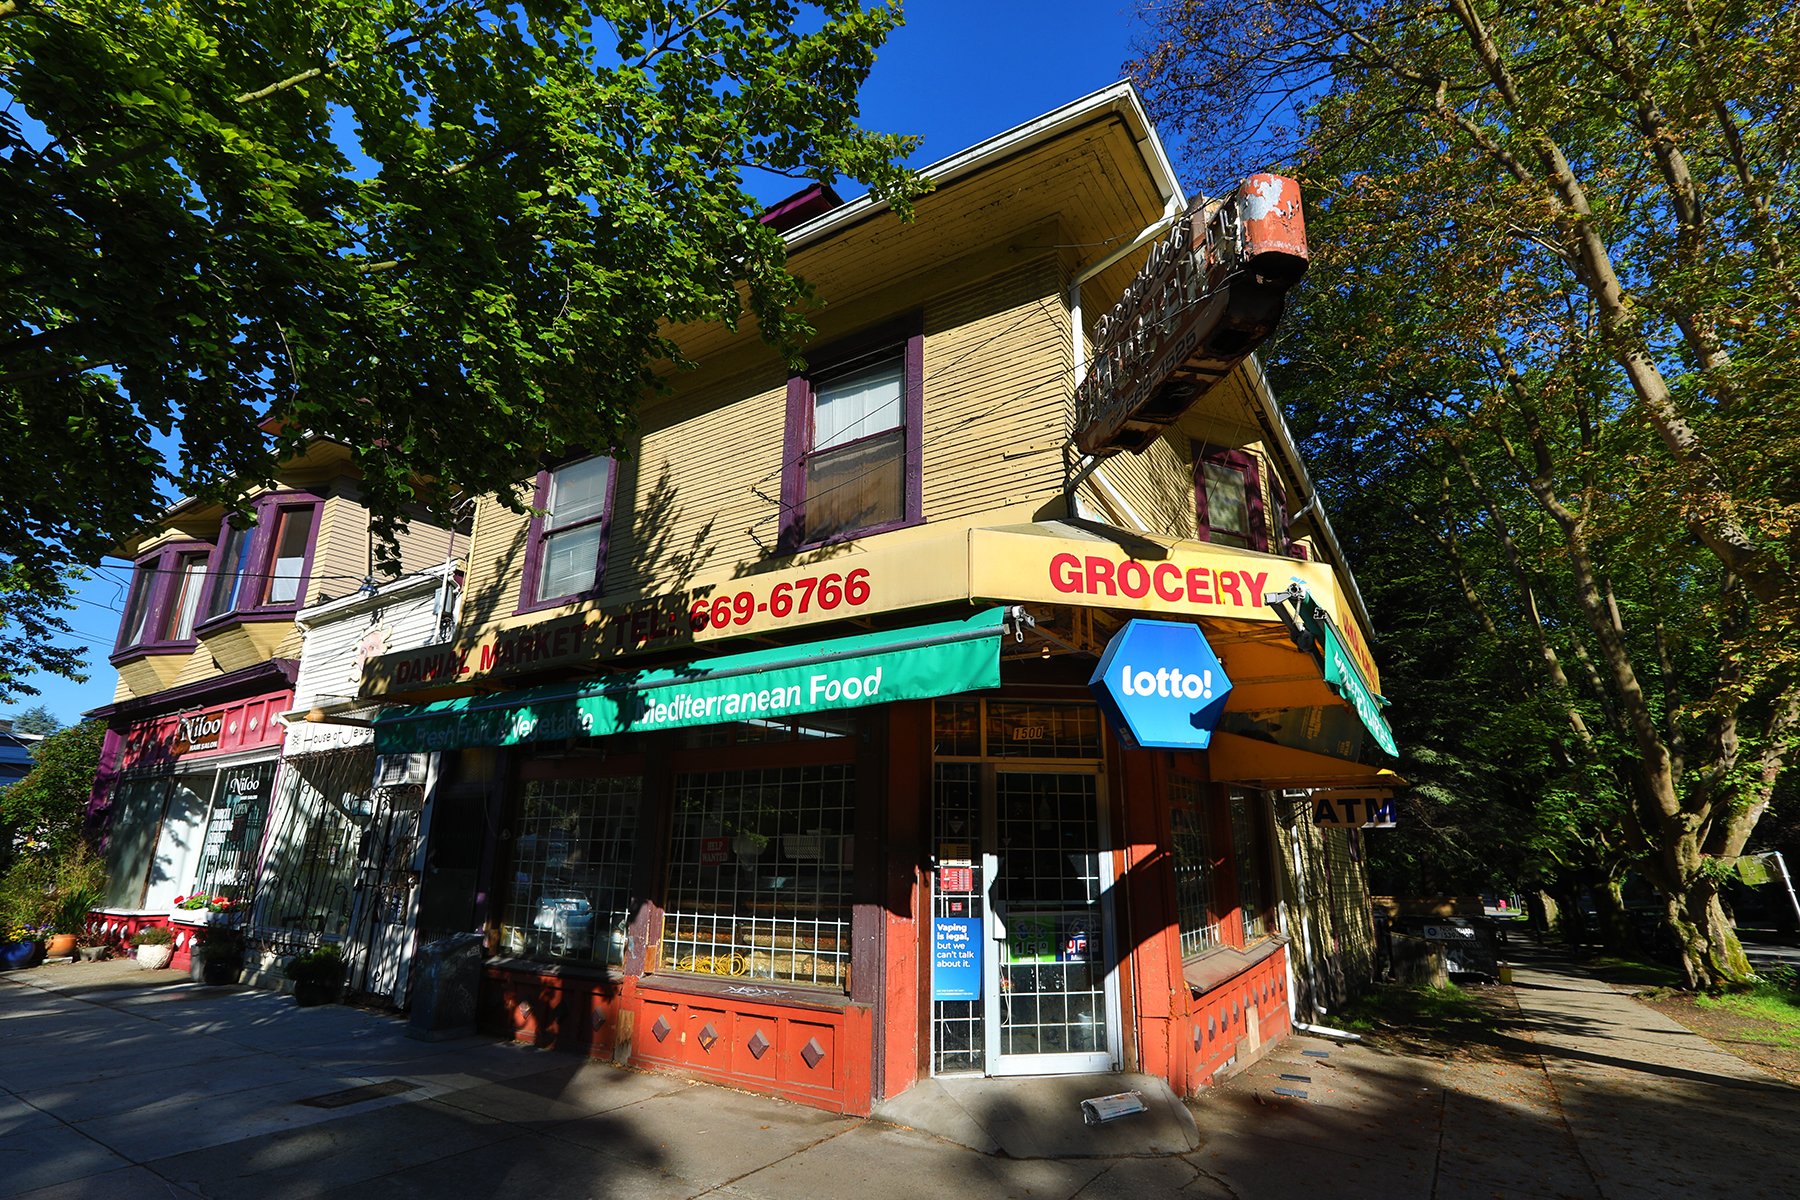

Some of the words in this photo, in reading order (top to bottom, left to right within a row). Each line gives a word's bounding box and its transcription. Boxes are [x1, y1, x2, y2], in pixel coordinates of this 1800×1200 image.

[1049, 552, 1269, 608] GROCERY
[396, 649, 470, 685] DANIAL
[479, 622, 590, 672] MARKET
[611, 608, 677, 646] TEL:
[689, 567, 872, 633] 669-6766
[1121, 665, 1213, 700] lotto!
[511, 707, 595, 741] Vegetable
[635, 682, 801, 725] Mediterranean
[809, 666, 882, 705] Food
[179, 715, 221, 744] Niloo
[1014, 727, 1043, 740] 1500
[303, 725, 332, 751] House
[333, 726, 343, 746] of
[230, 776, 260, 795] Niloo
[1313, 798, 1397, 823] ATM
[707, 841, 723, 850] HELP
[702, 852, 729, 862] WANTED
[936, 923, 968, 933] Vaping
[936, 932, 945, 941] is
[946, 932, 970, 942] legal,
[936, 942, 952, 950] but
[936, 951, 958, 959] can't
[958, 951, 975, 959] talk
[936, 959, 962, 968] about
[962, 959, 971, 968] it.
